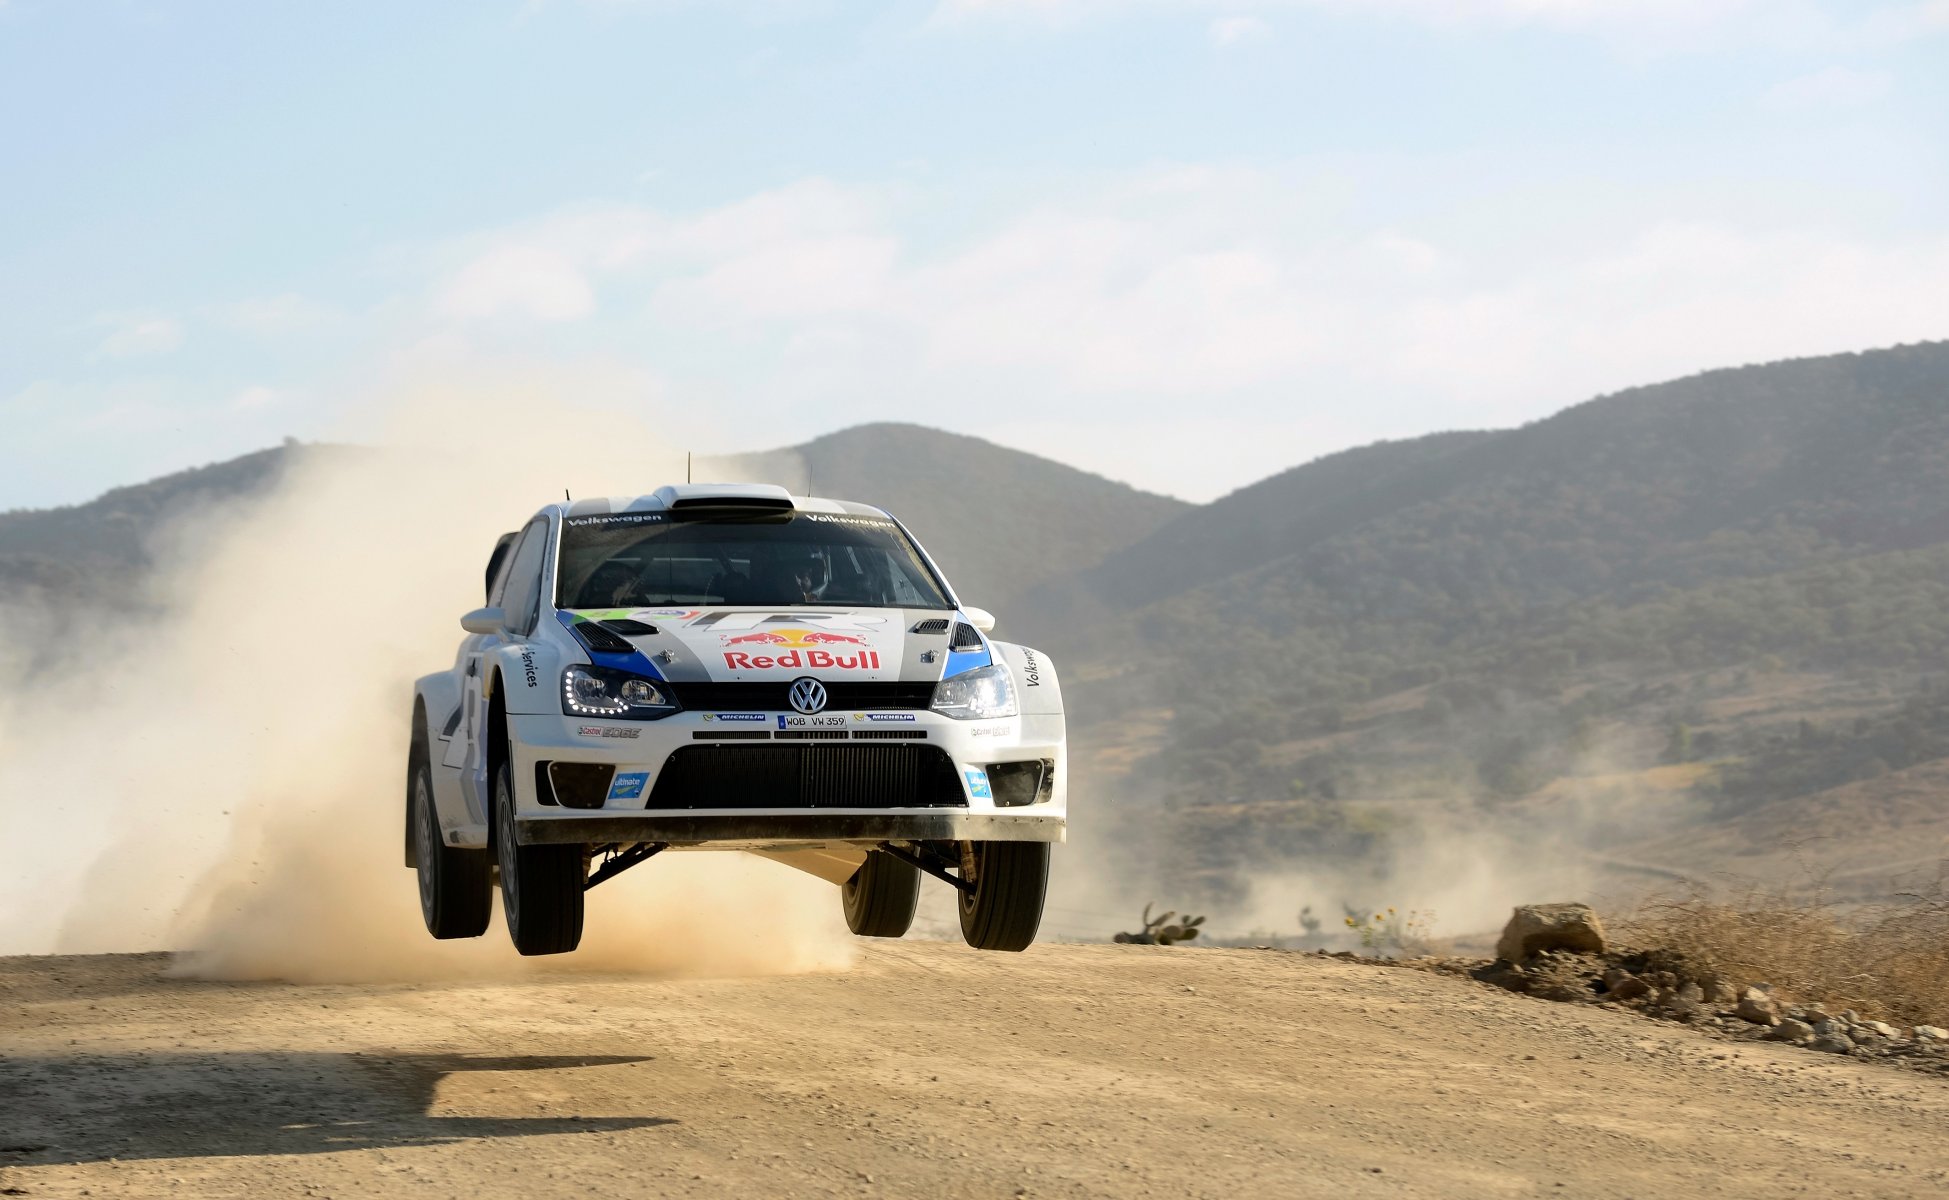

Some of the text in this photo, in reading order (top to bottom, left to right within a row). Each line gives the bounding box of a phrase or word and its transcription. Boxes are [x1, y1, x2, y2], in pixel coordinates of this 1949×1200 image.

[568, 515, 663, 527] Volkswagen
[805, 514, 896, 528] Volkswagen
[722, 650, 880, 670] Red Bull
[521, 651, 539, 688] Services
[721, 713, 765, 721] MICHELIN
[786, 716, 844, 727] WOB VW 359
[873, 713, 915, 721] MICHELIN
[602, 728, 642, 739] EDGE
